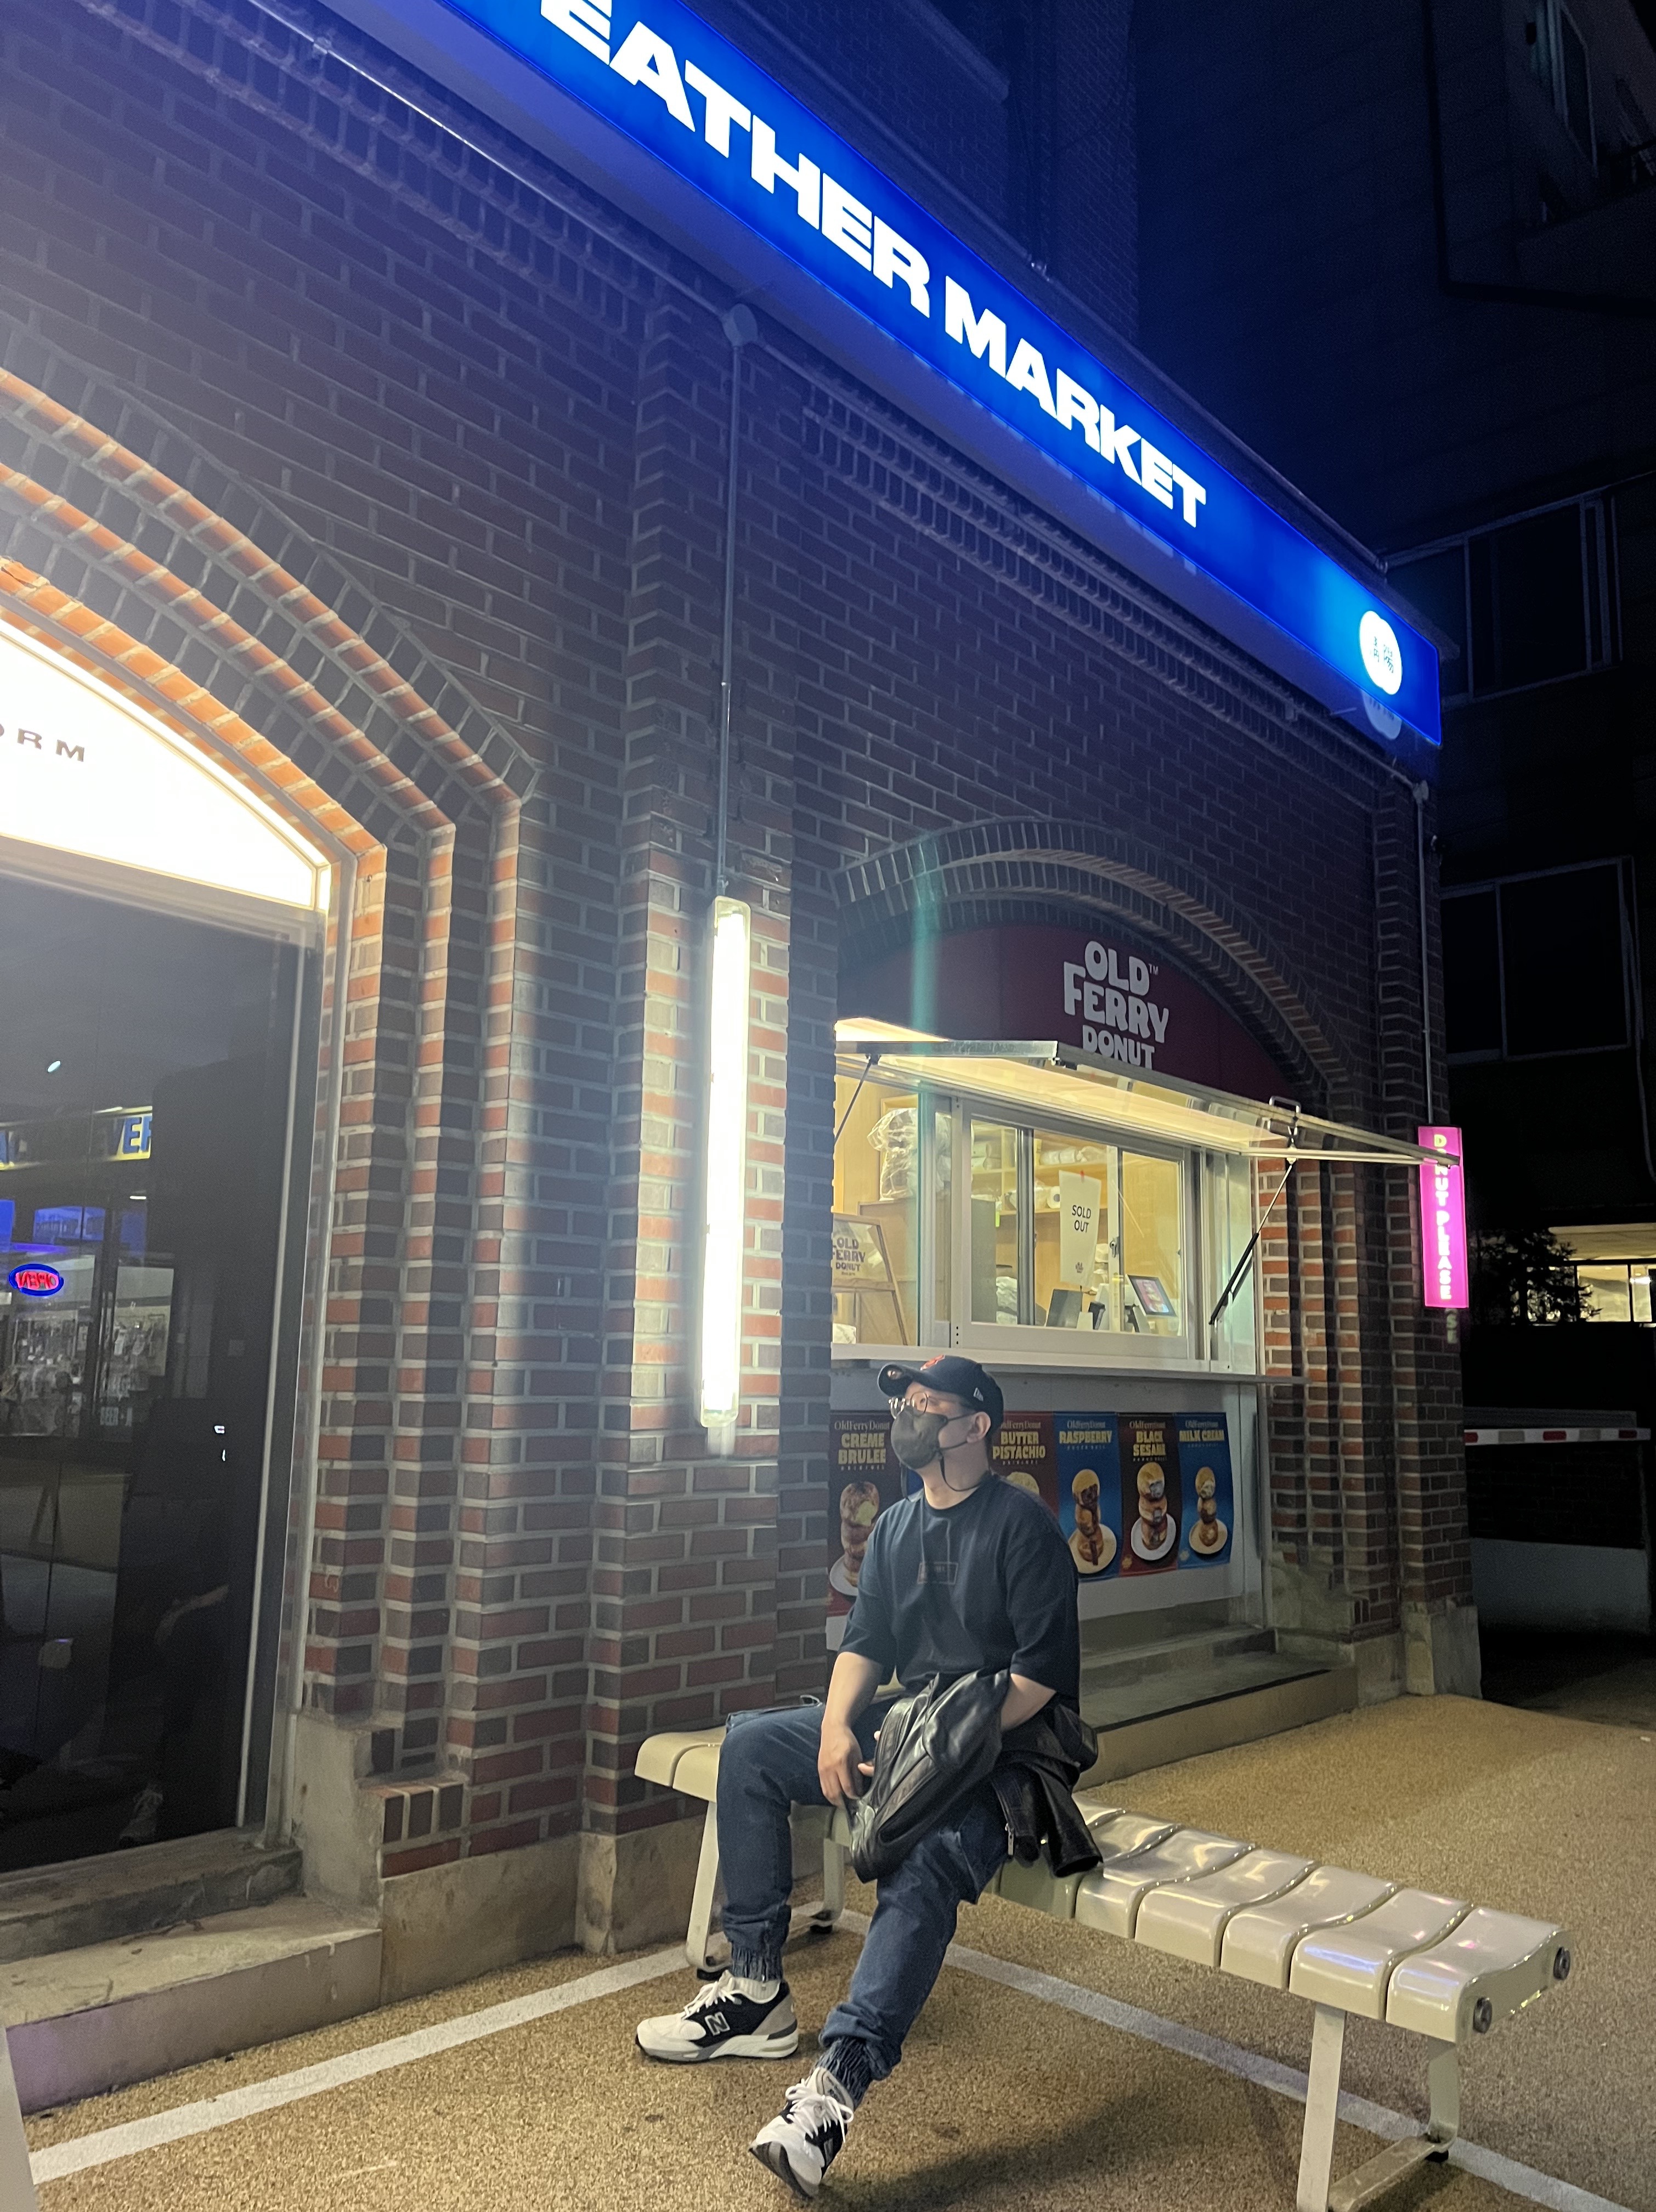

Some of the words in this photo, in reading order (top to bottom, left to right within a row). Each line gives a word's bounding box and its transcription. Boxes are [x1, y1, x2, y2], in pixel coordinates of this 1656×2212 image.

[945, 275, 1206, 528] MARKET
[0, 724, 84, 762] RM
[1085, 941, 1150, 996] OLD
[1064, 961, 1169, 1043] FERRY
[1083, 1025, 1155, 1069] DONUT
[1072, 1205, 1091, 1219] SOLD
[1074, 1220, 1089, 1233] OUT
[837, 1237, 860, 1250] OLD
[1436, 1210, 1452, 1300] PLEASE
[835, 1262, 861, 1271] DONUT
[841, 1433, 885, 1448] CREME
[1001, 1431, 1039, 1444] BUTTER
[1059, 1431, 1112, 1444] RASPBERRY
[1136, 1430, 1163, 1443] BLACK
[1179, 1430, 1200, 1442] MILK
[1202, 1430, 1225, 1442] CREAM
[838, 1448, 886, 1464] BRULEE
[993, 1446, 1046, 1460] PISTACHIO
[704, 2012, 730, 2036] N
